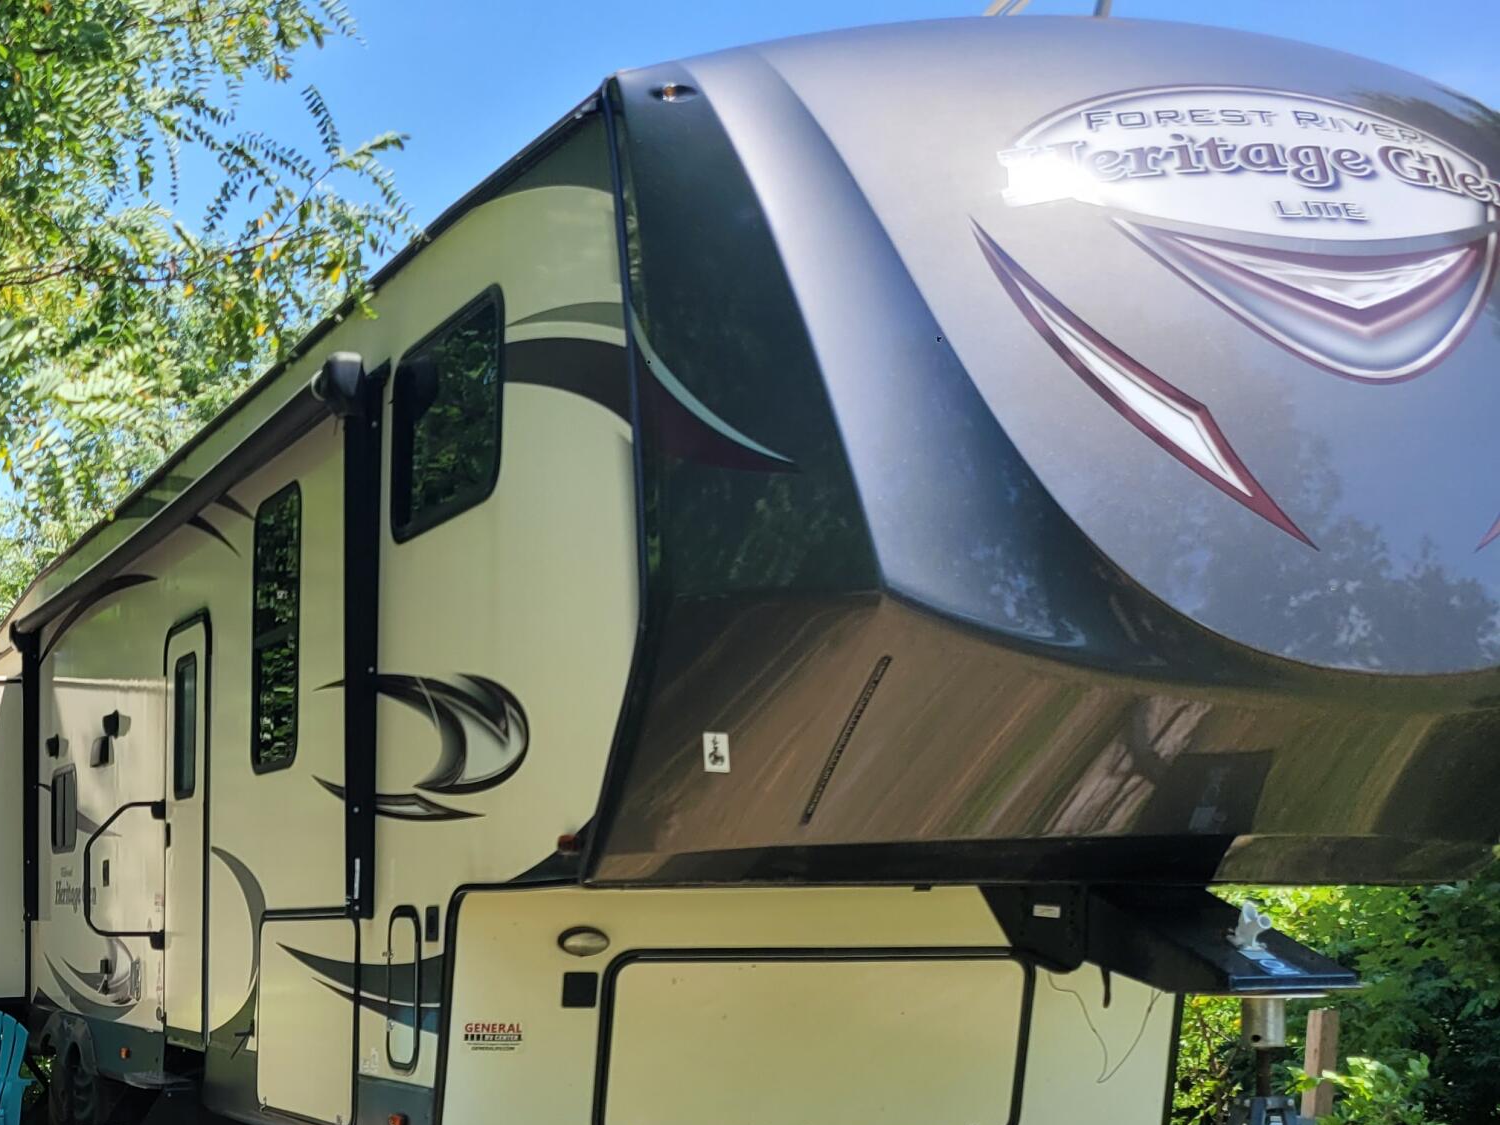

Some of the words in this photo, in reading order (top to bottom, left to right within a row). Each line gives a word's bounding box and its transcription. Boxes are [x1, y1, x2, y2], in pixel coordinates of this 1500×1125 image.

[1082, 107, 1276, 132] FOREST
[1293, 110, 1425, 144] RIVER
[1271, 200, 1369, 222] LITE
[464, 1023, 522, 1033] GENERAL
